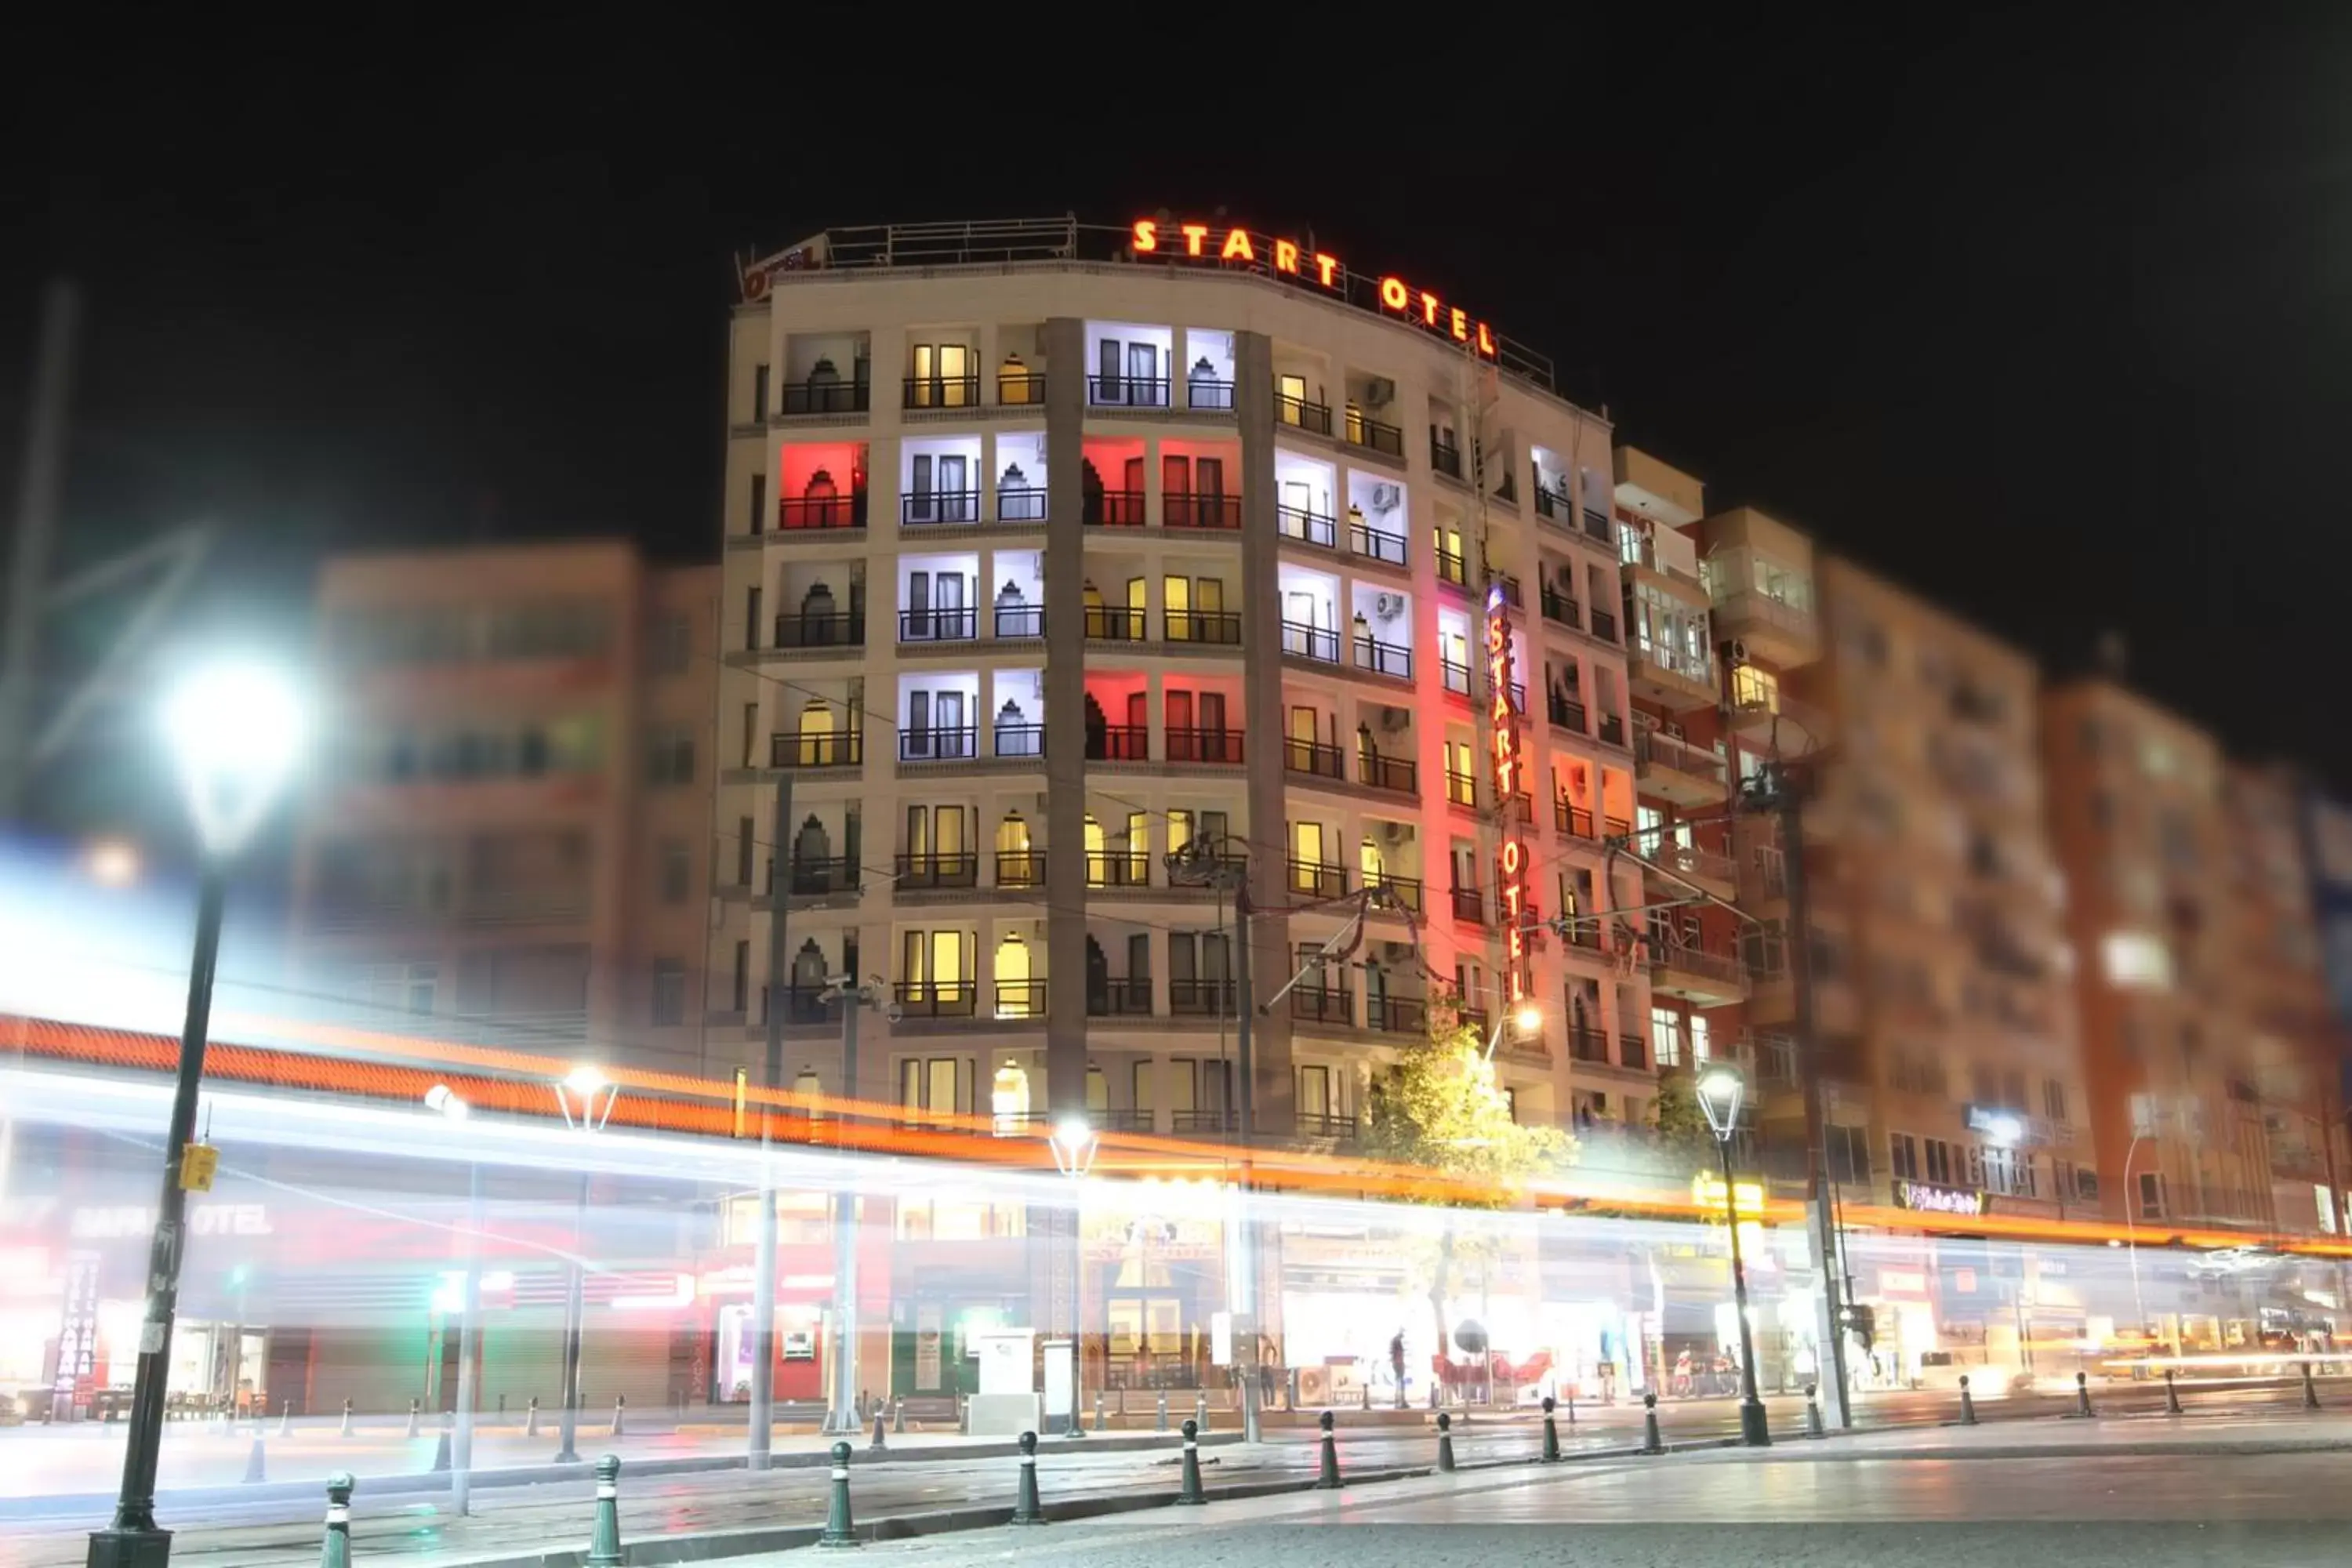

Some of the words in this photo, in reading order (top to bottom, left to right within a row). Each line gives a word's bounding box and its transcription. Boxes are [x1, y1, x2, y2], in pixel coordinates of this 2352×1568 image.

[1134, 221, 1336, 286] START
[1381, 278, 1494, 354] OTEL
[1490, 615, 1513, 794] START
[1503, 840, 1523, 1002] OTEL
